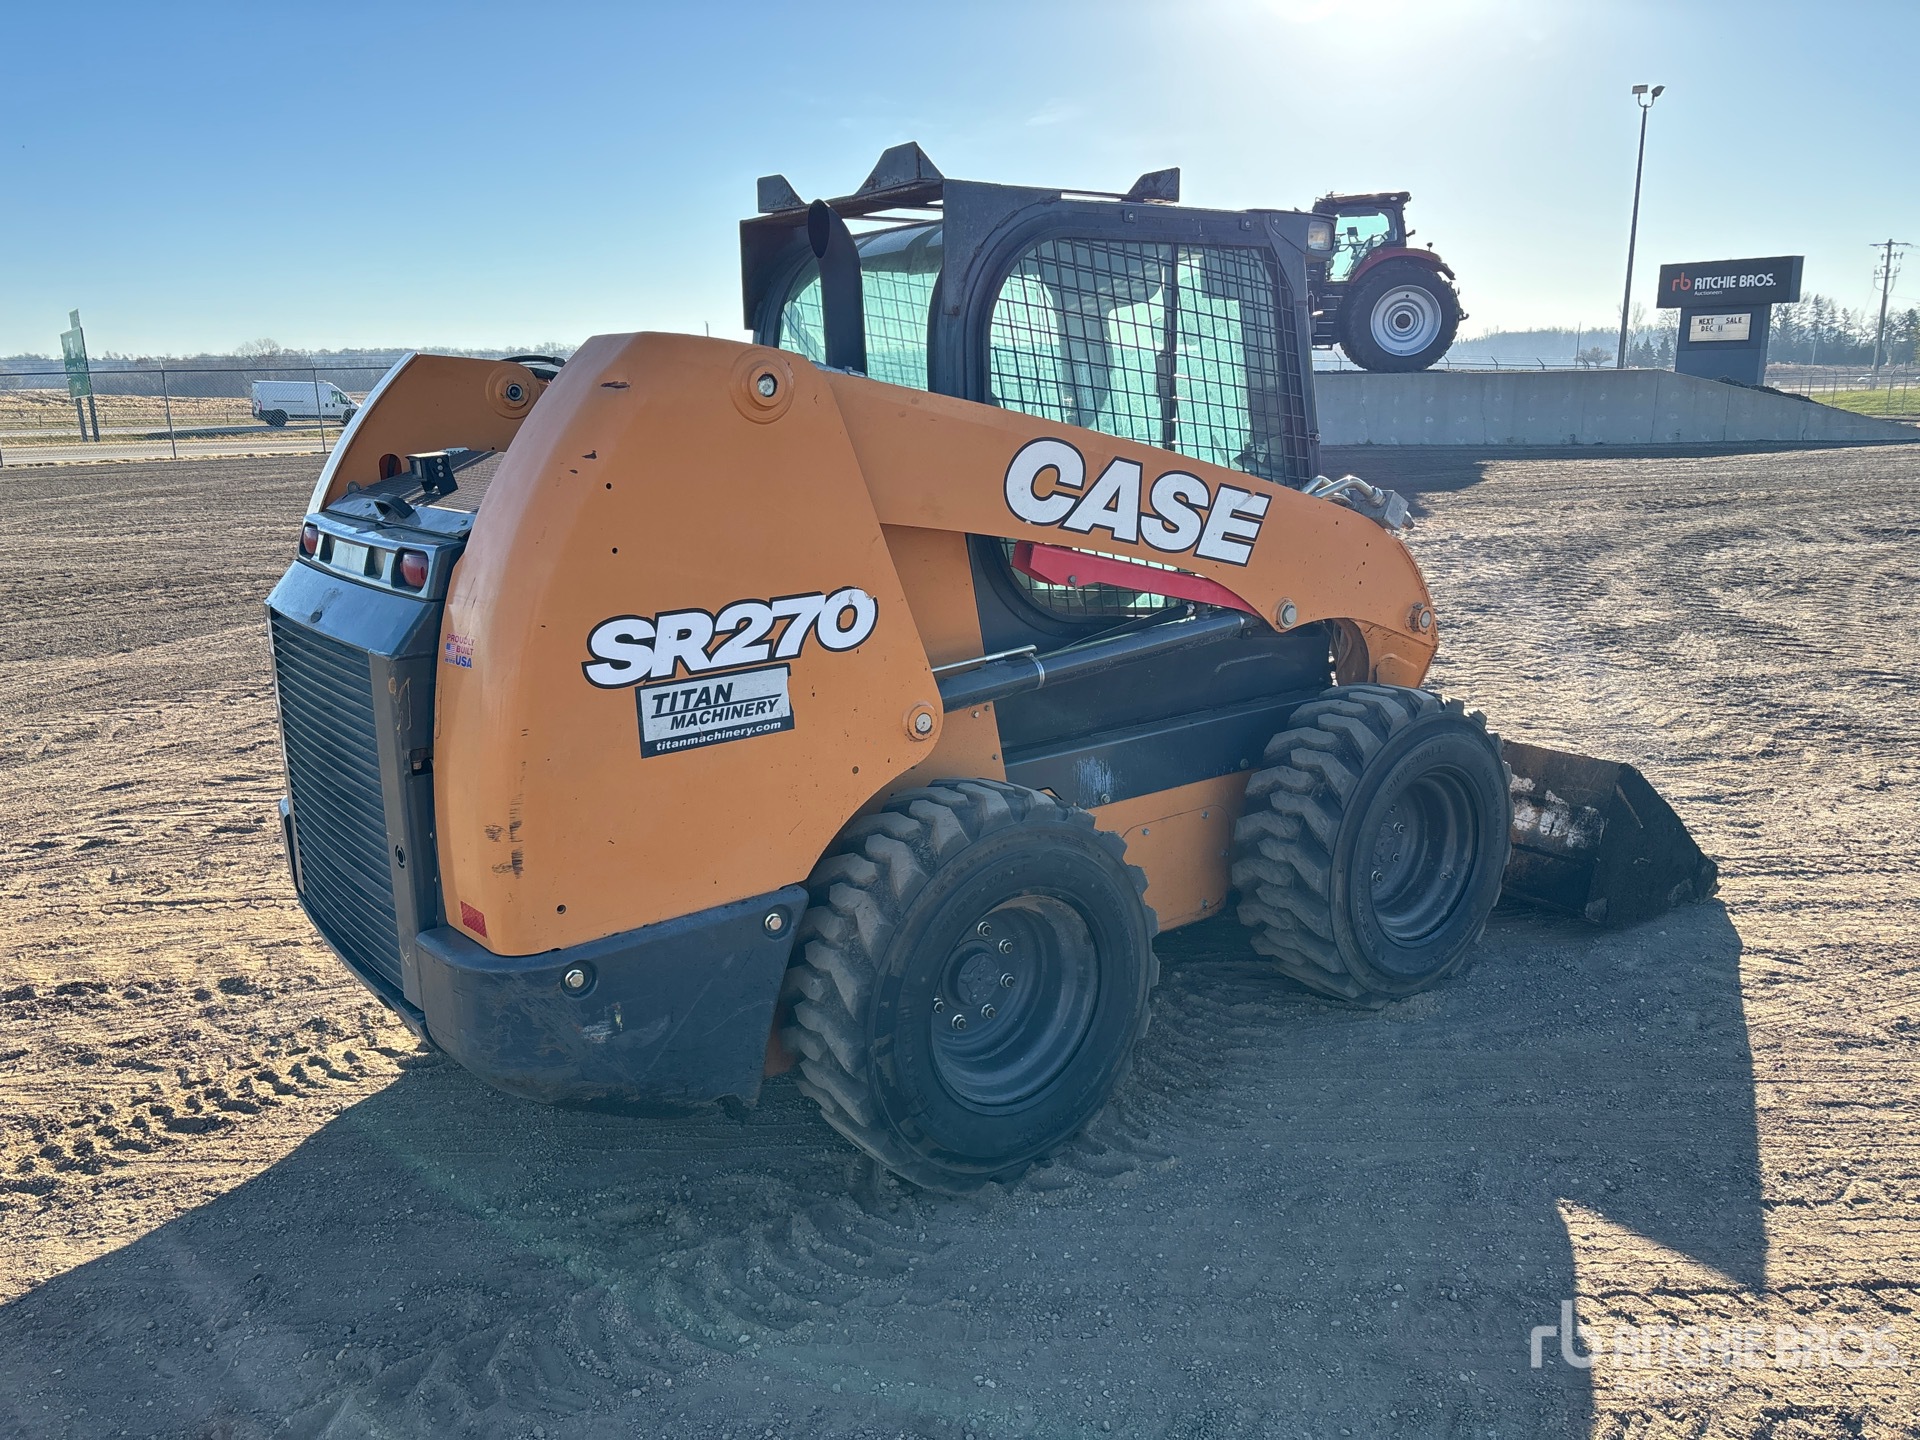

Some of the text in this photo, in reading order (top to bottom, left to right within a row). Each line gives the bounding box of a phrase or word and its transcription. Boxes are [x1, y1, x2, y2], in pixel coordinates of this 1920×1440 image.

[1672, 272, 1776, 291] rb RITCHIE BROS.
[1004, 437, 1272, 567] CASE
[446, 633, 475, 646] PROUDLY
[456, 645, 474, 655] BUILT
[582, 586, 878, 688] SR270
[455, 655, 472, 668] USA
[651, 683, 733, 715] TITAN
[670, 698, 779, 730] MACHINERY
[656, 721, 781, 751] titanmachinery.com
